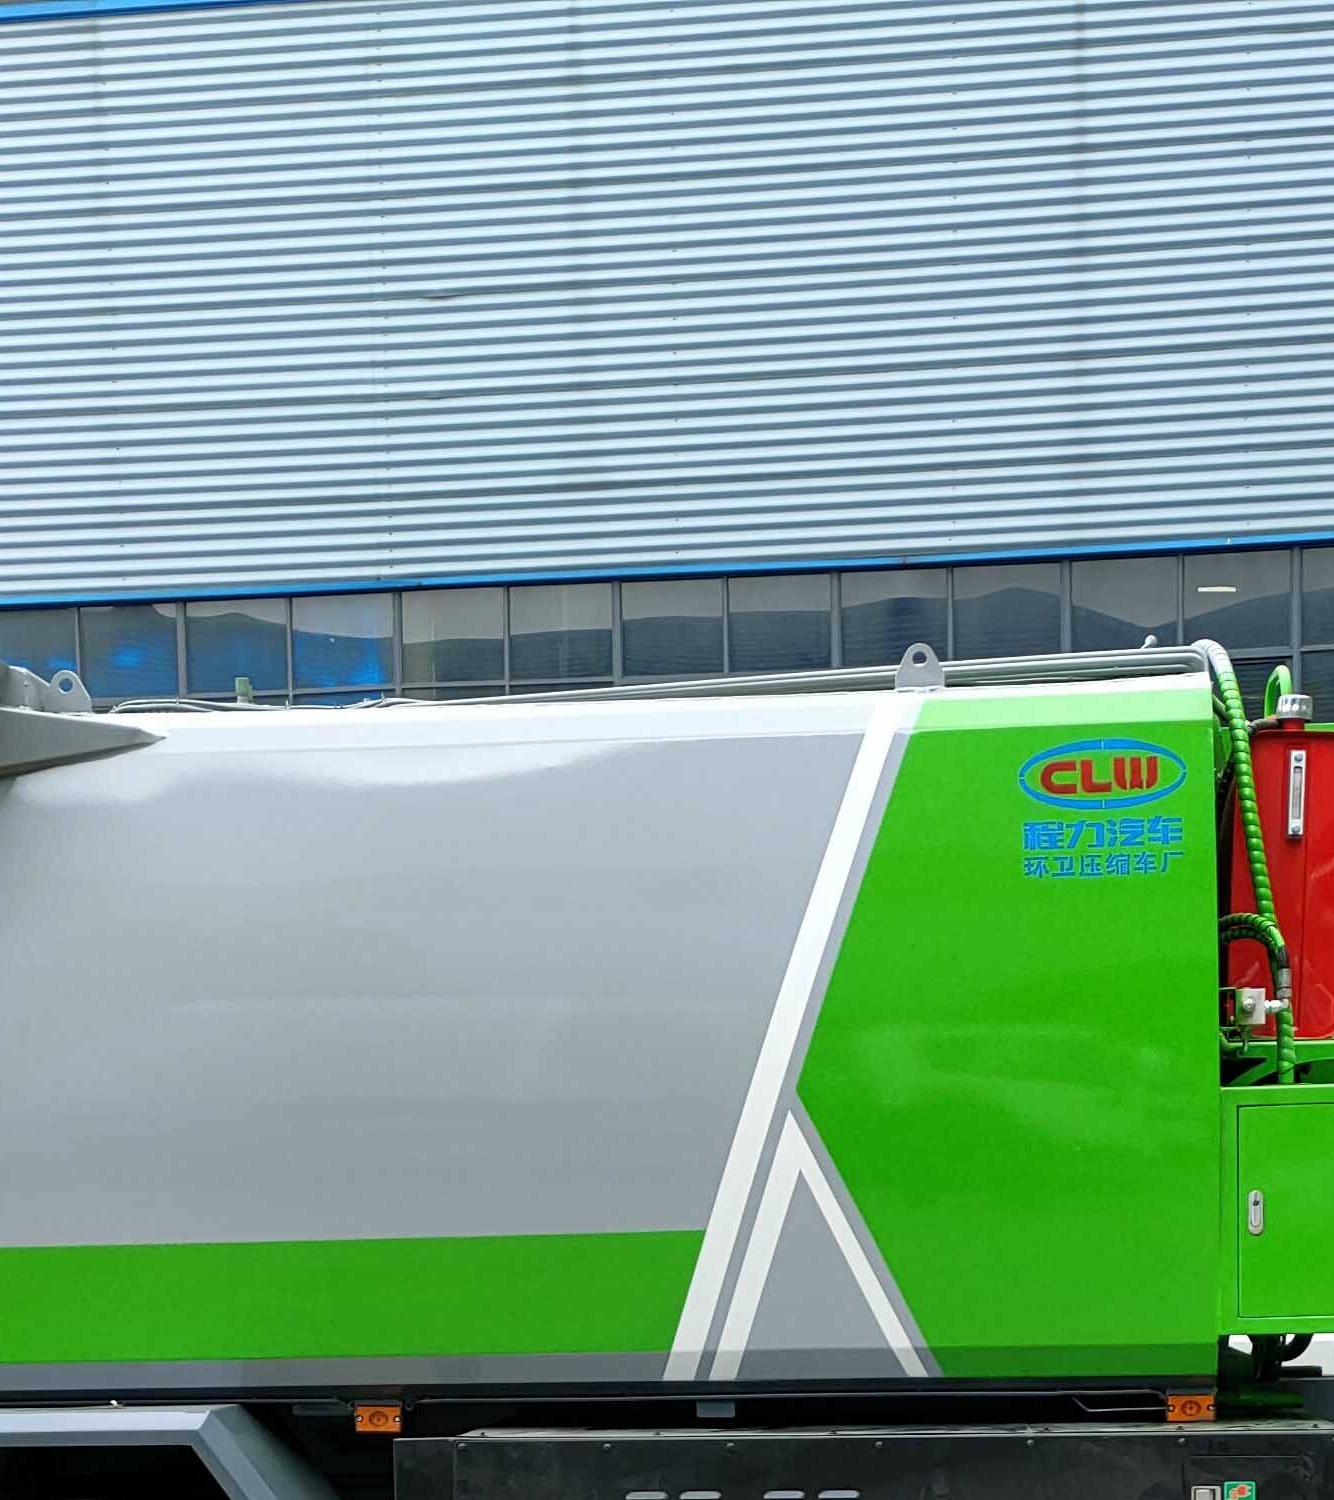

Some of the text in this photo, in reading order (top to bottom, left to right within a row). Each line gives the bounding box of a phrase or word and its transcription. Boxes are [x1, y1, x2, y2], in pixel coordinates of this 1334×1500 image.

[1040, 755, 1158, 795] CLW
[1022, 815, 1183, 850] 程力汽车
[1023, 851, 1184, 878] 环卫压缩车厂
